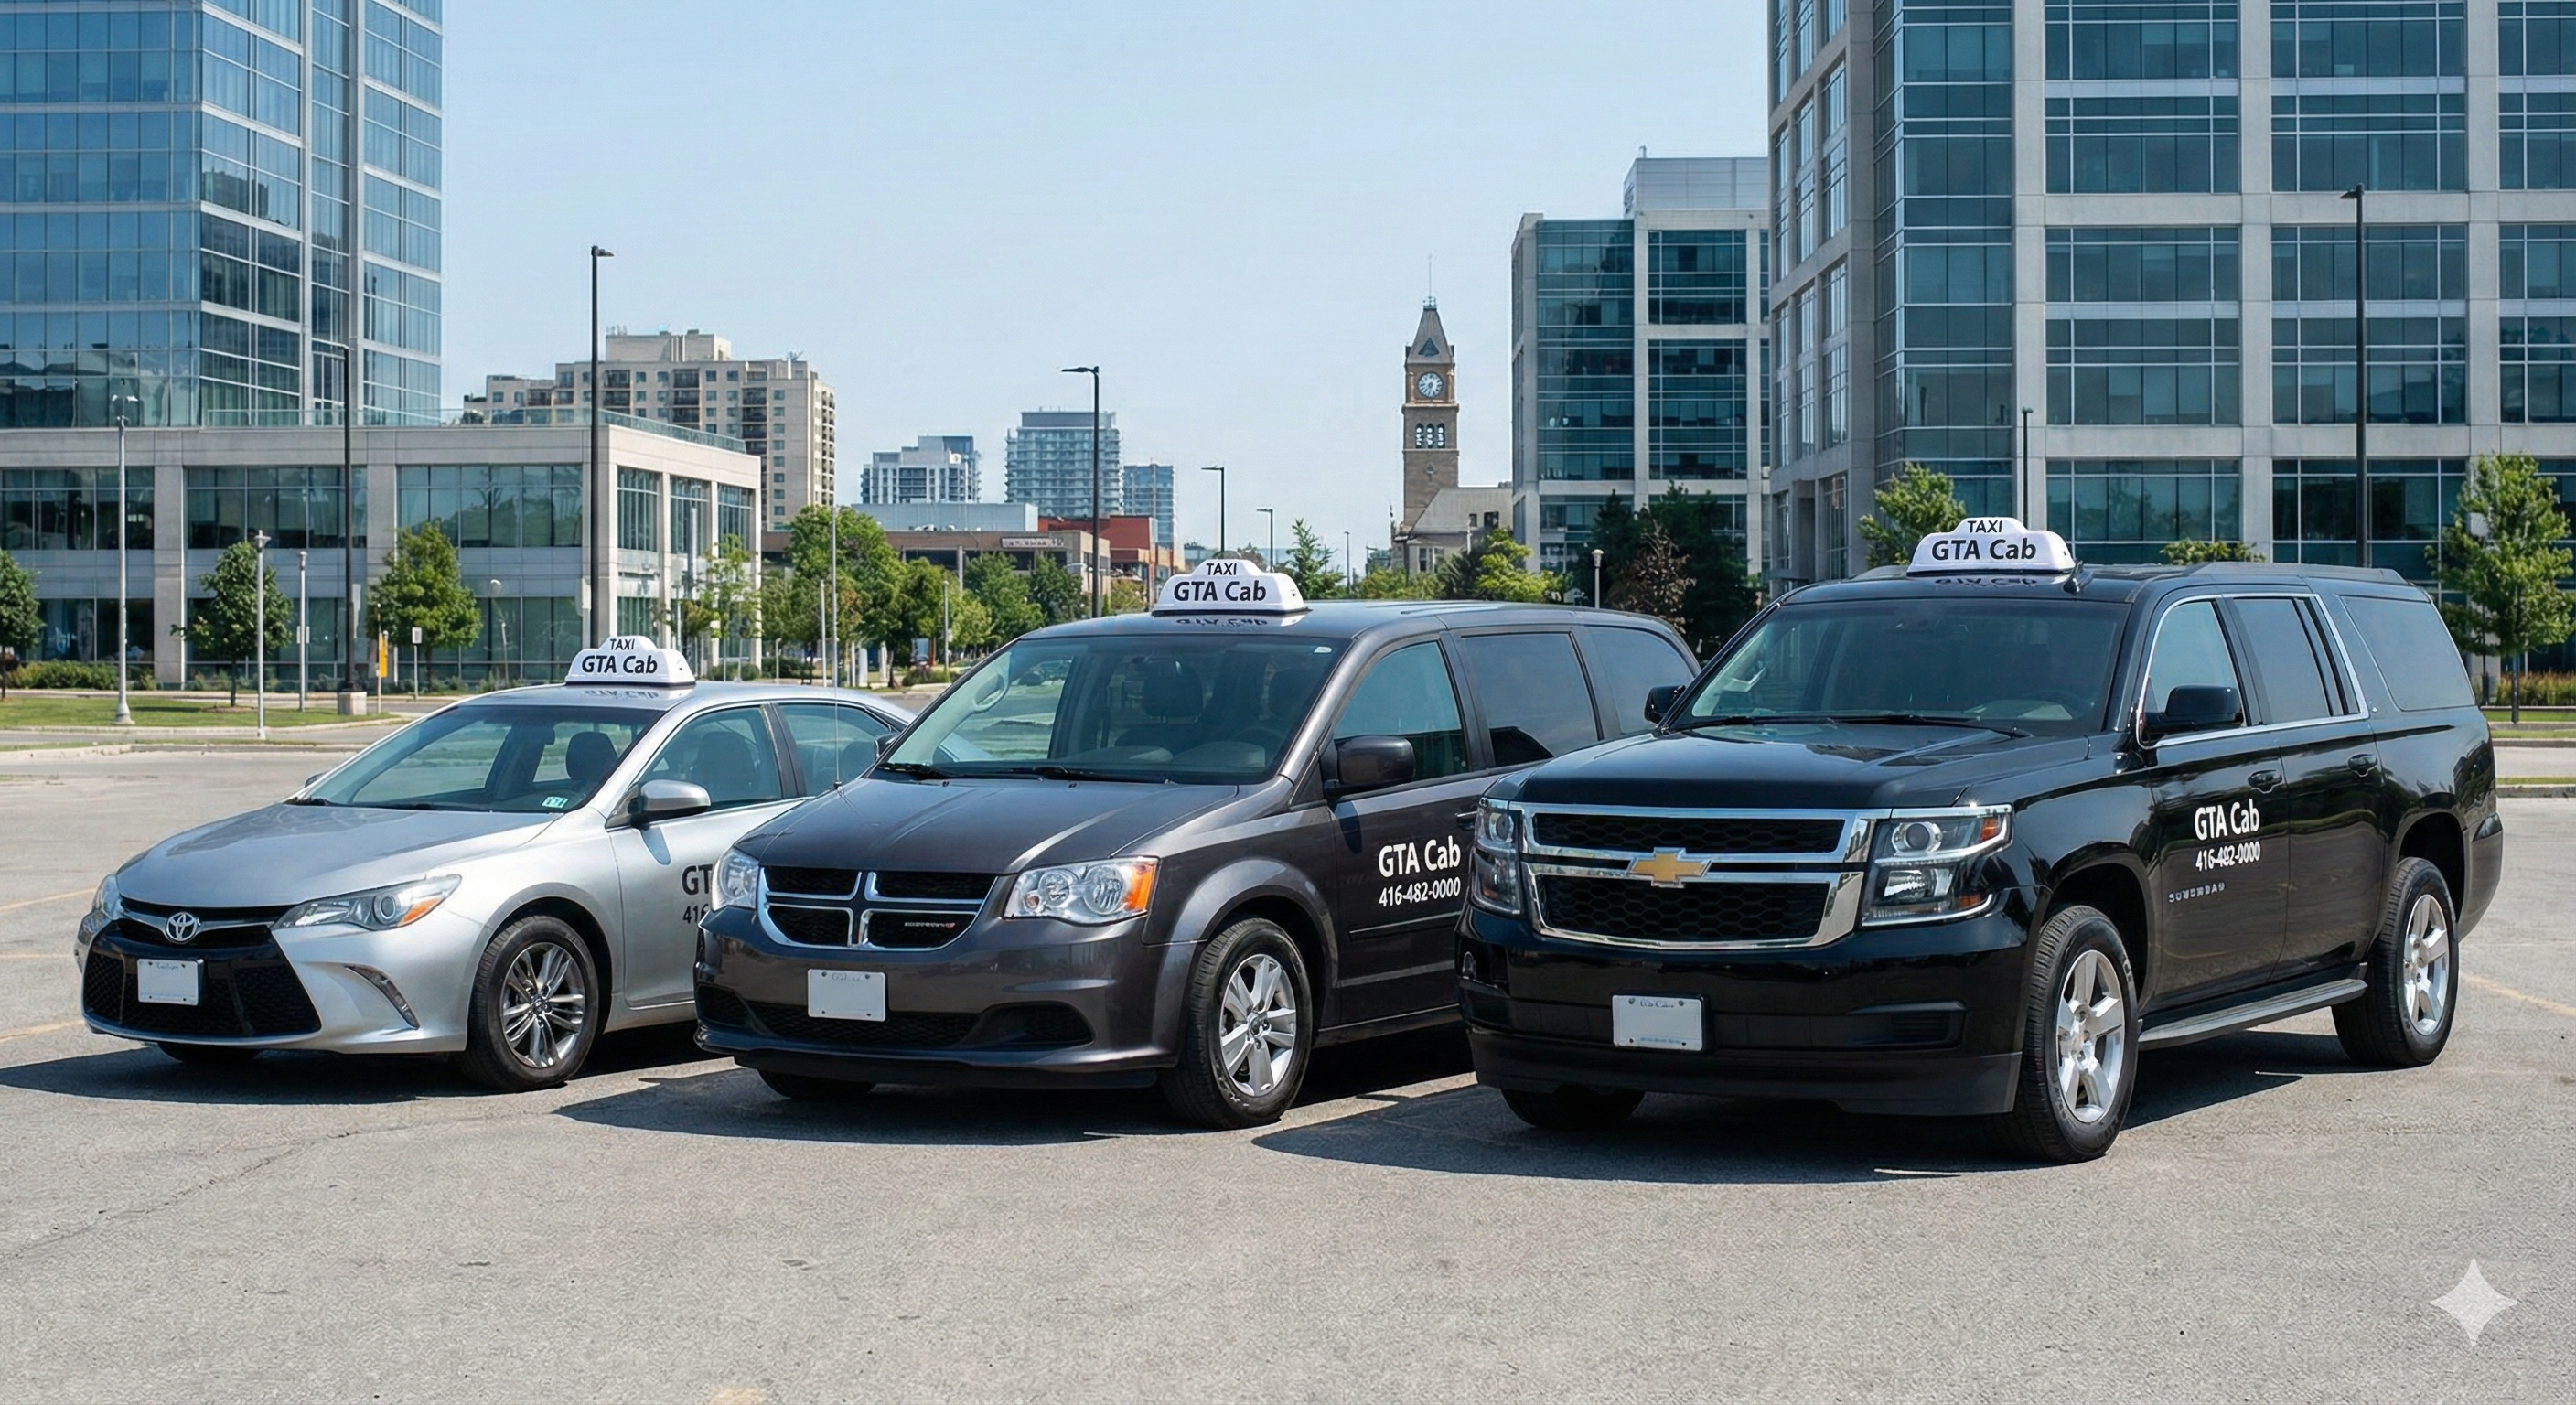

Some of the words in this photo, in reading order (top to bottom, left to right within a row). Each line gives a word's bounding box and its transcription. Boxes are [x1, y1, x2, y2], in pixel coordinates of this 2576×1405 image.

[1967, 520, 2003, 533] TAXI
[1932, 539, 1980, 561] GTA
[1989, 537, 2037, 560] Cab
[1206, 563, 1237, 576] TAXI
[1174, 581, 1218, 602] GTA
[1224, 579, 1266, 602] Cab
[610, 638, 635, 650] TAXI
[582, 655, 617, 673] GTA
[623, 655, 658, 674] Cab
[2195, 804, 2228, 841] GTA
[2230, 798, 2259, 835] Cab
[1379, 842, 1421, 878] GTA
[1424, 835, 1461, 871] Cab
[682, 863, 713, 896] GT
[1379, 876, 1462, 907] 416-482-0000
